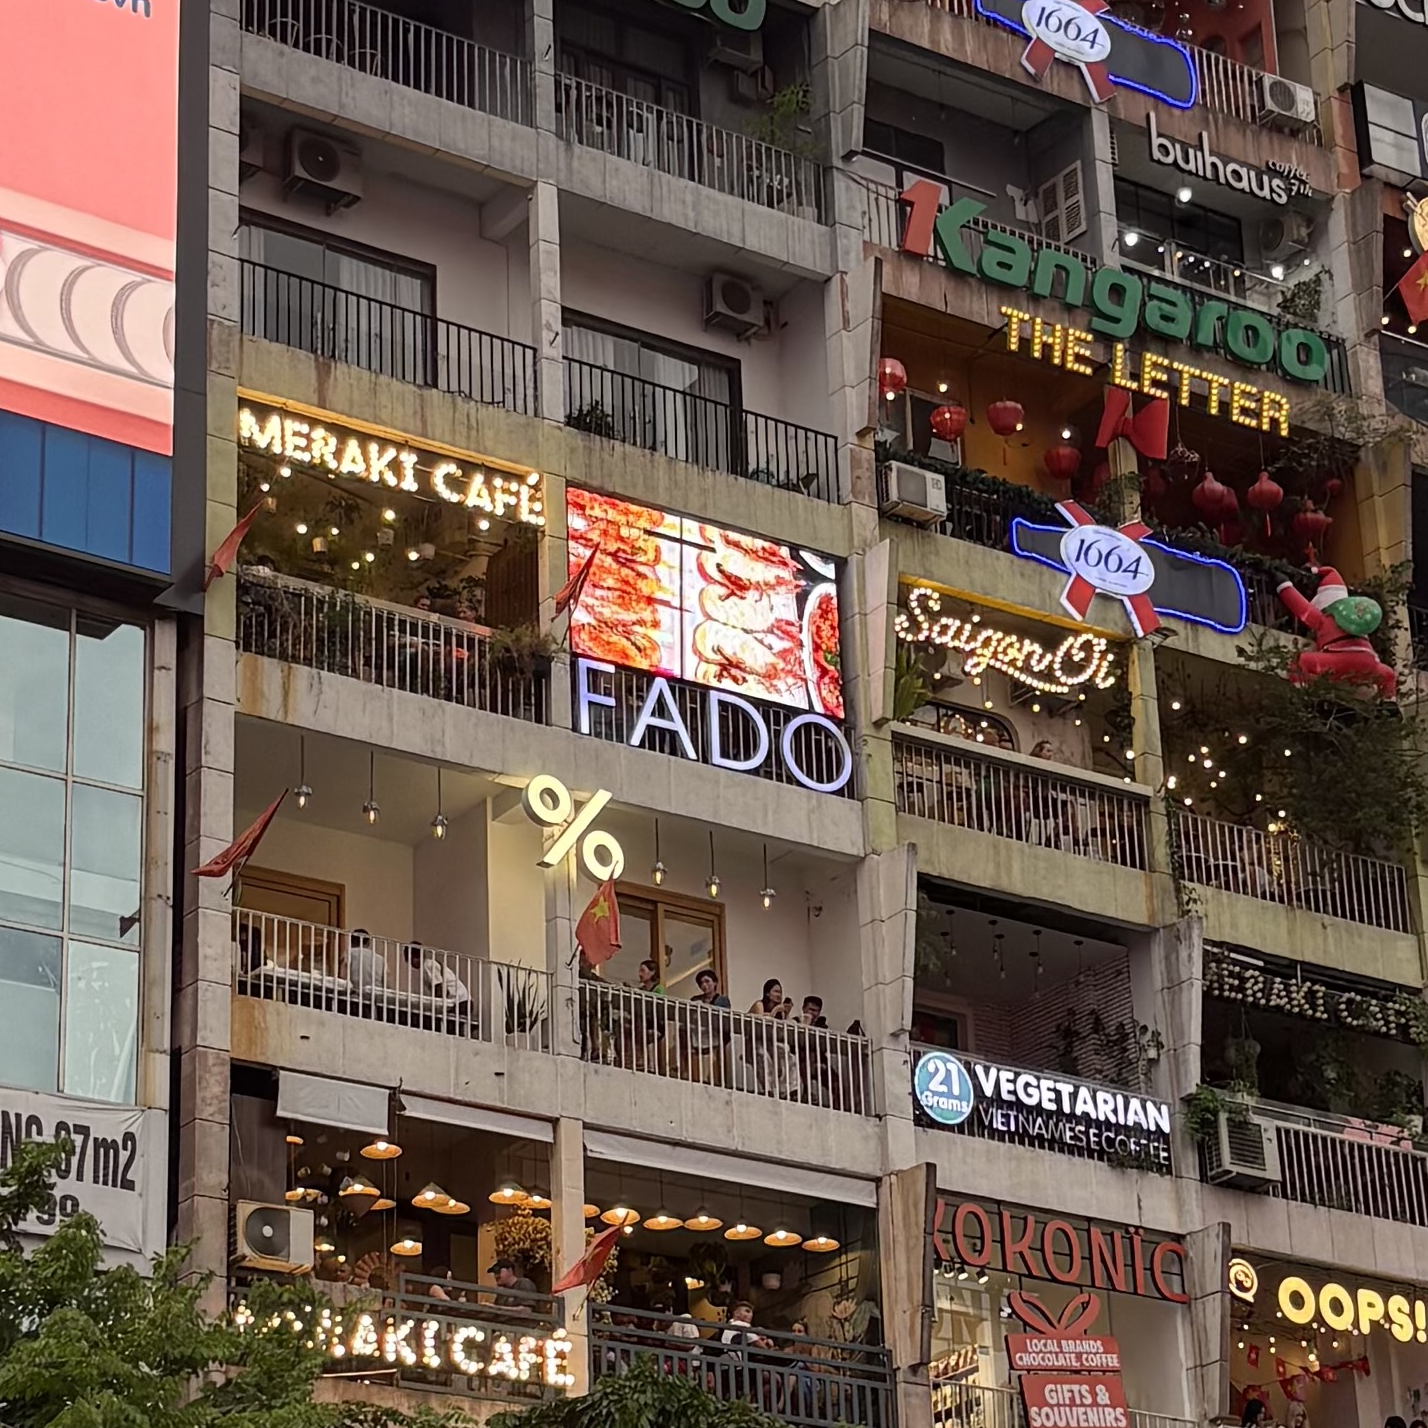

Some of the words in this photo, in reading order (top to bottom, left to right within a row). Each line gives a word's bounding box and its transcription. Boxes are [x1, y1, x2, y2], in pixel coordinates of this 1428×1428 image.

[1035, 5, 1106, 51] 1664
[1001, 306, 1093, 376] THE
[1110, 342, 1291, 438] LETTER
[237, 407, 420, 493] MERAKI
[1073, 538, 1148, 581] 1664
[574, 657, 854, 793] FADO
[920, 1090, 969, 1114] Grams
[927, 1058, 960, 1097] 21
[974, 1063, 1171, 1135] VEGETARIAN
[1277, 1275, 1428, 1344] OOPS!
[1025, 1338, 1060, 1354] LOCAL
[1061, 1340, 1104, 1354] BRANDS
[1081, 1353, 1121, 1368] COFFEE
[1043, 1383, 1093, 1406] GIFTS
[1095, 1383, 1111, 1406] &
[1029, 1406, 1127, 1428] SOUVENIRS
